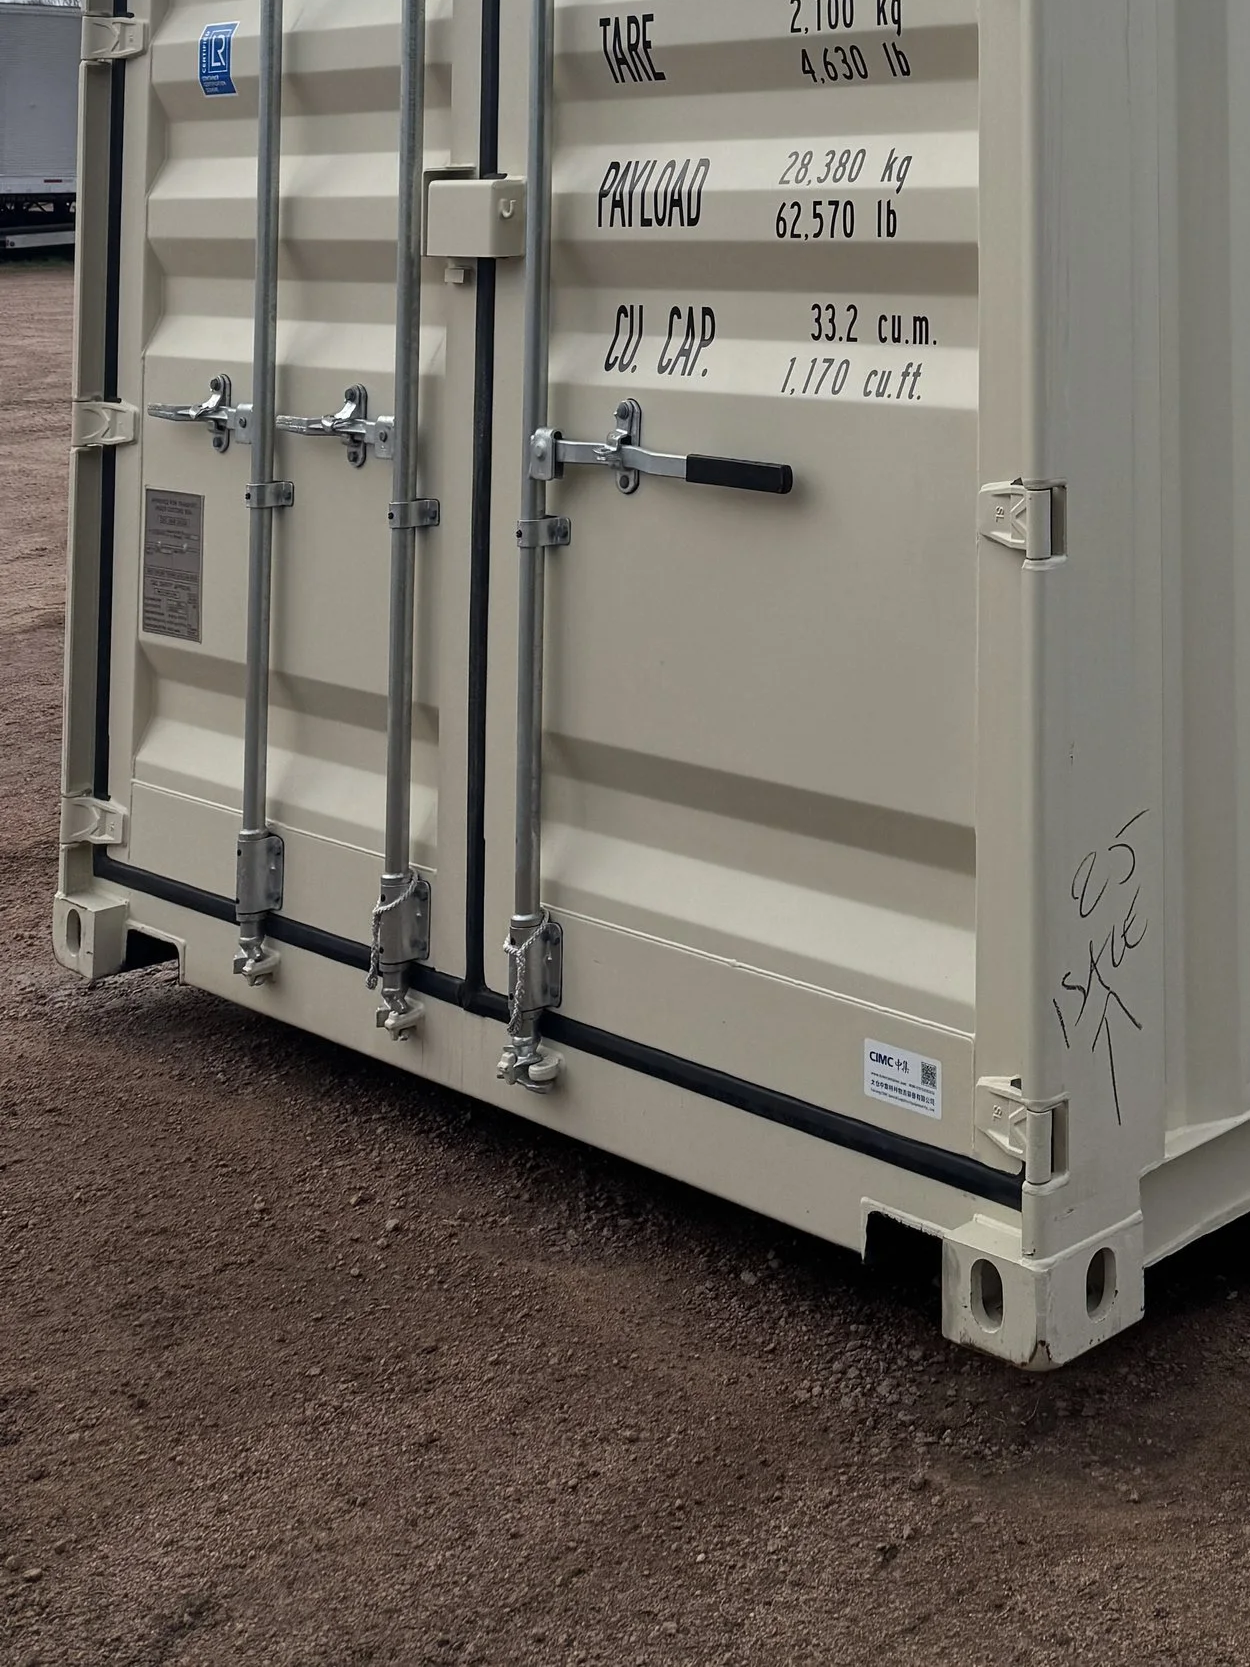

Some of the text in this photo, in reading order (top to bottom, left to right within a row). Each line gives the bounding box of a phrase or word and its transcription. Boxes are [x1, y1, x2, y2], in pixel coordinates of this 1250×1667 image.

[600, 13, 667, 84] TARE
[801, 41, 912, 84] 4,630 lb
[597, 147, 913, 228] PAYLOAD 28,380 kg
[775, 199, 898, 240] 62,570 lb
[604, 303, 938, 378] CU. CAP. 33.2 cu.m.
[780, 356, 924, 401] 1,170 cu.ft.
[869, 1051, 894, 1068] CIMC
